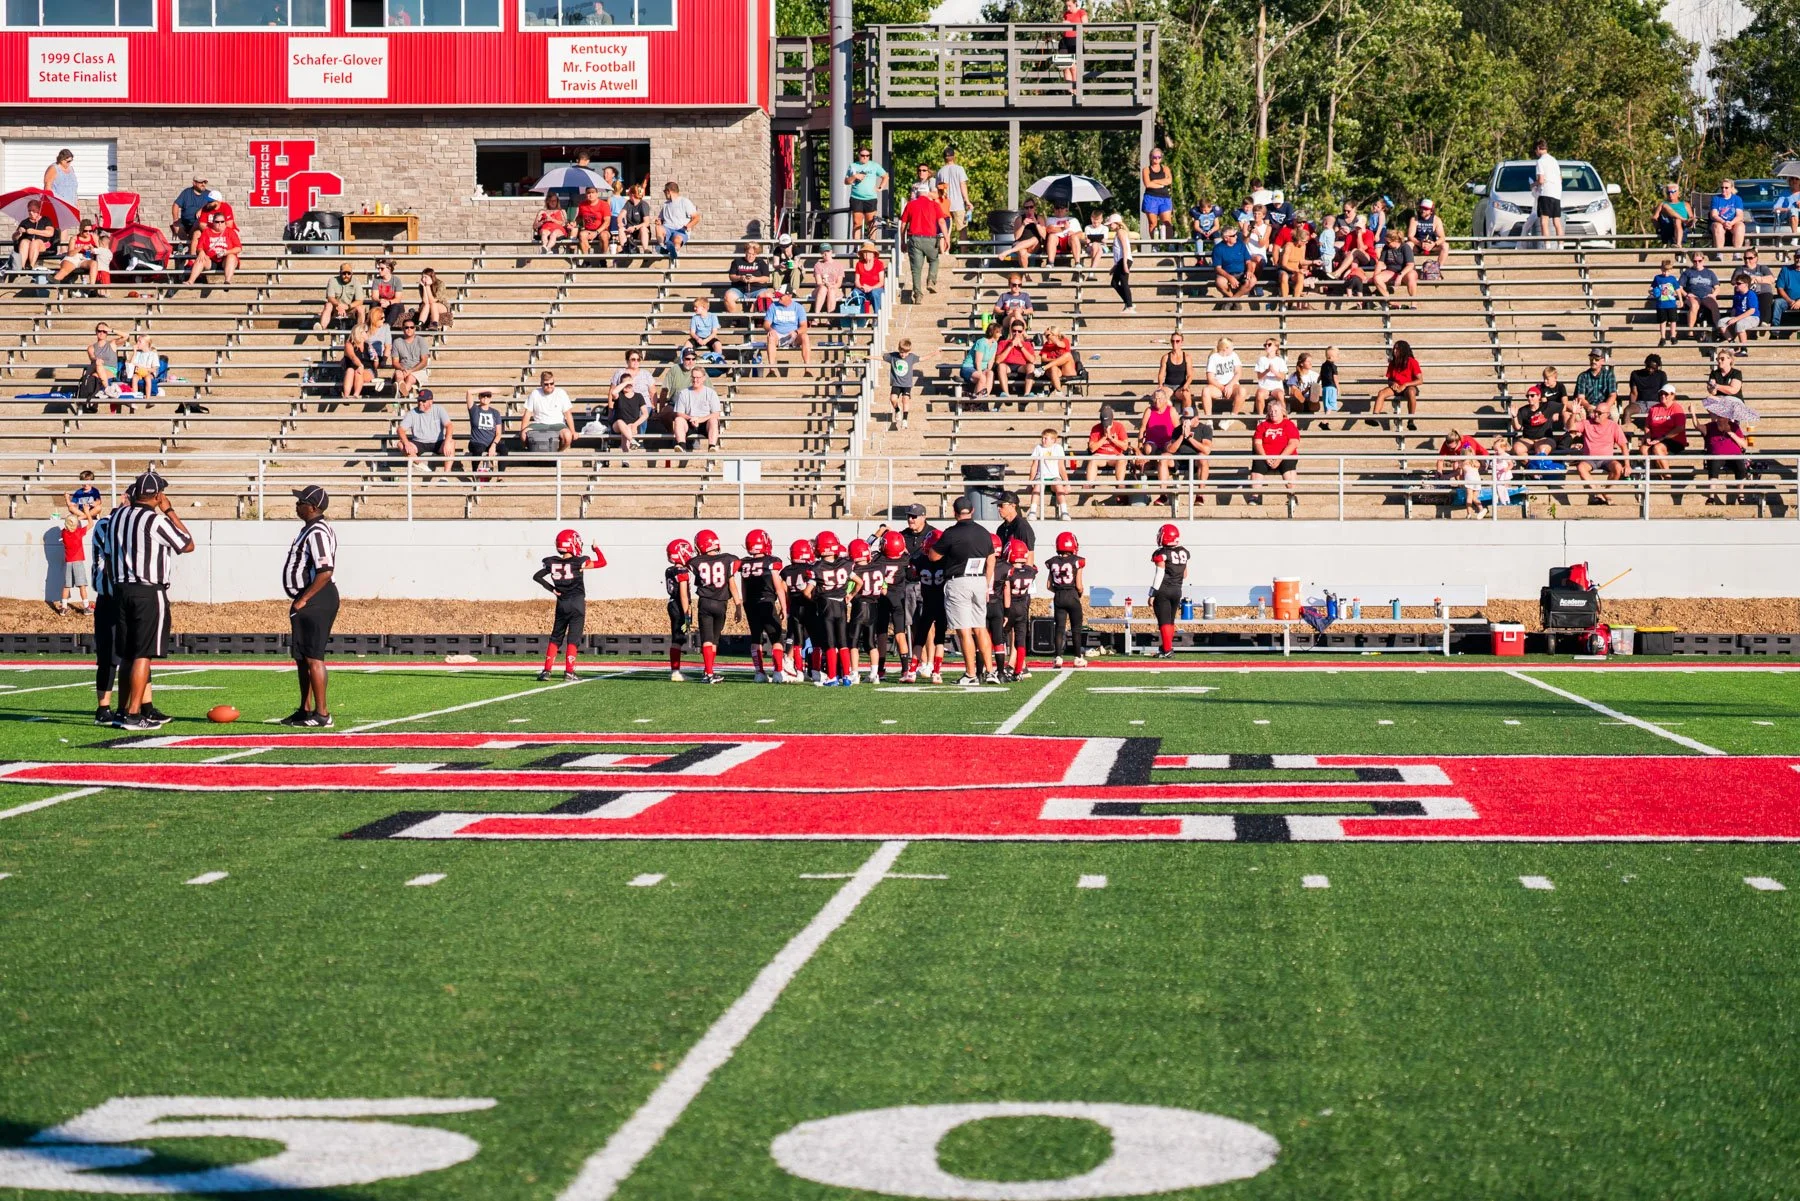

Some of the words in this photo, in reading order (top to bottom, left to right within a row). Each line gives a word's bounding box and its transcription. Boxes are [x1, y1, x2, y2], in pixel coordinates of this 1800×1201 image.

[570, 44, 628, 57] Kentucky
[40, 53, 70, 65] 1999
[73, 52, 104, 65] Class
[107, 53, 116, 65] A
[292, 53, 384, 66] Schafer-Glover
[563, 61, 582, 73] Mr.
[585, 60, 636, 73] Football
[39, 71, 70, 83] State
[73, 71, 118, 83] Finalist
[323, 72, 353, 84] Field
[561, 79, 596, 91] Travis
[599, 79, 638, 91] Atwell
[260, 144, 270, 205] HORNETS
[551, 563, 574, 580] 51
[698, 561, 726, 589] 98
[1050, 562, 1074, 585] 23
[861, 570, 884, 596] 12
[1559, 598, 1588, 607] Academy
